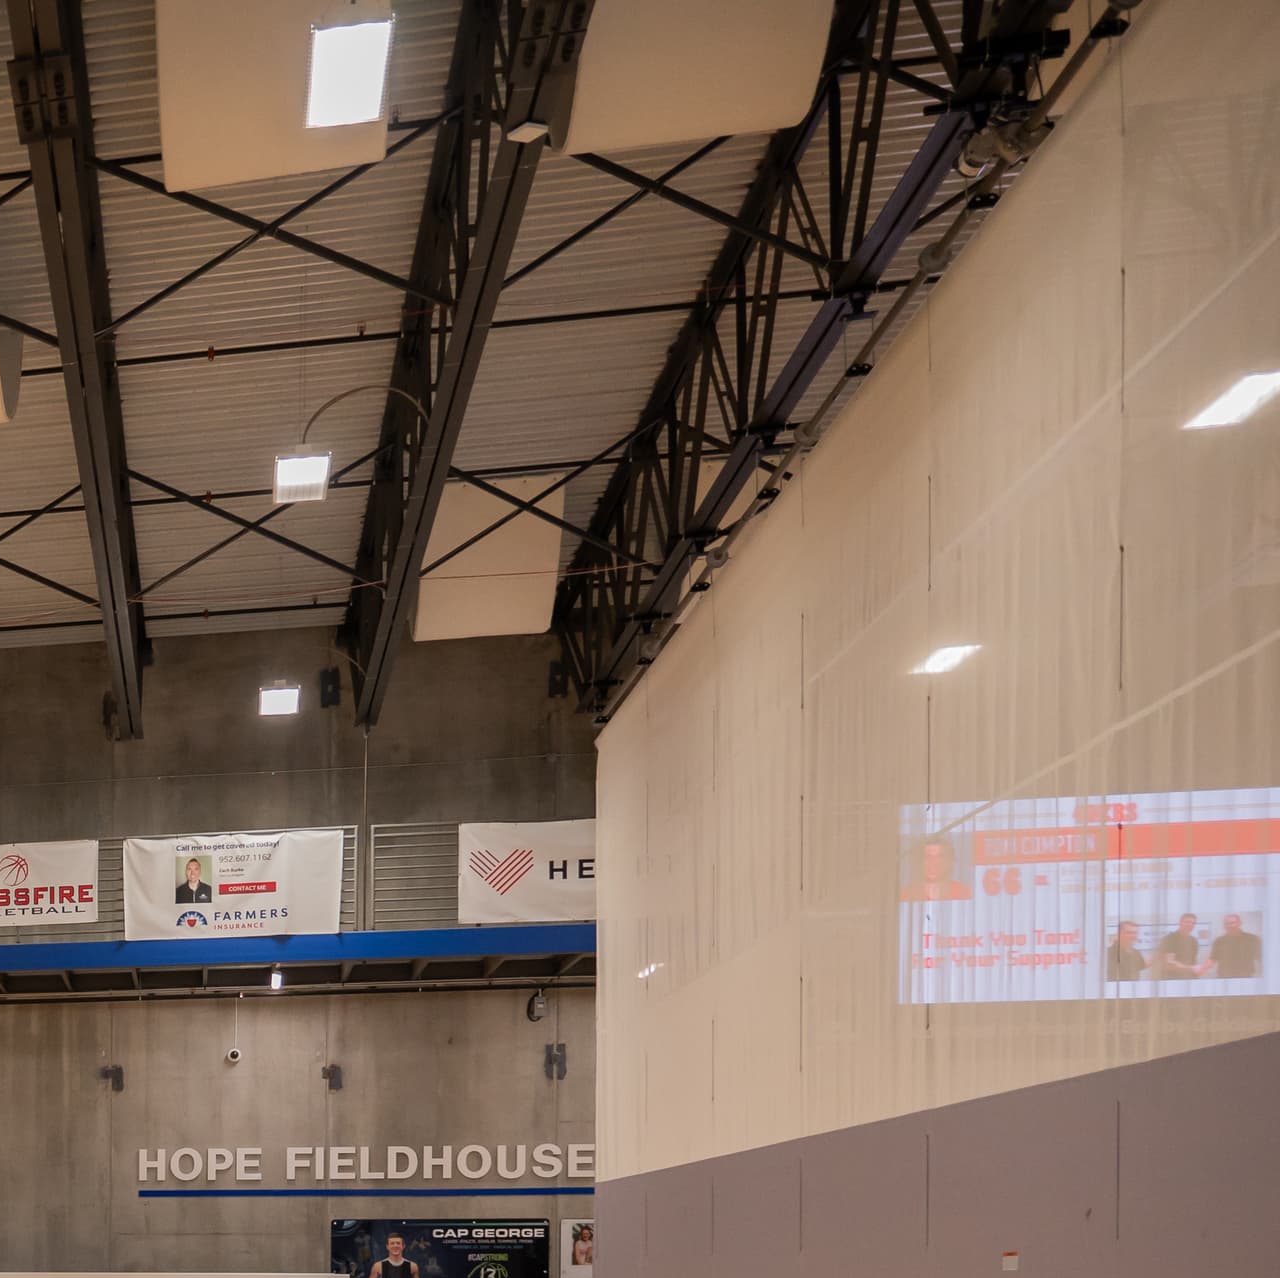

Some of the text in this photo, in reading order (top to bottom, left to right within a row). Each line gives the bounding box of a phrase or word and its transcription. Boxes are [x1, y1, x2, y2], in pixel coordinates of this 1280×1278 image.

[218, 854, 272, 863] 952.607.1162
[981, 867, 1021, 896] 66
[214, 908, 288, 921] FARMERS
[138, 1143, 596, 1182] HOPE FIELDHOUSE
[432, 1228, 545, 1238] CAP GEORGE
